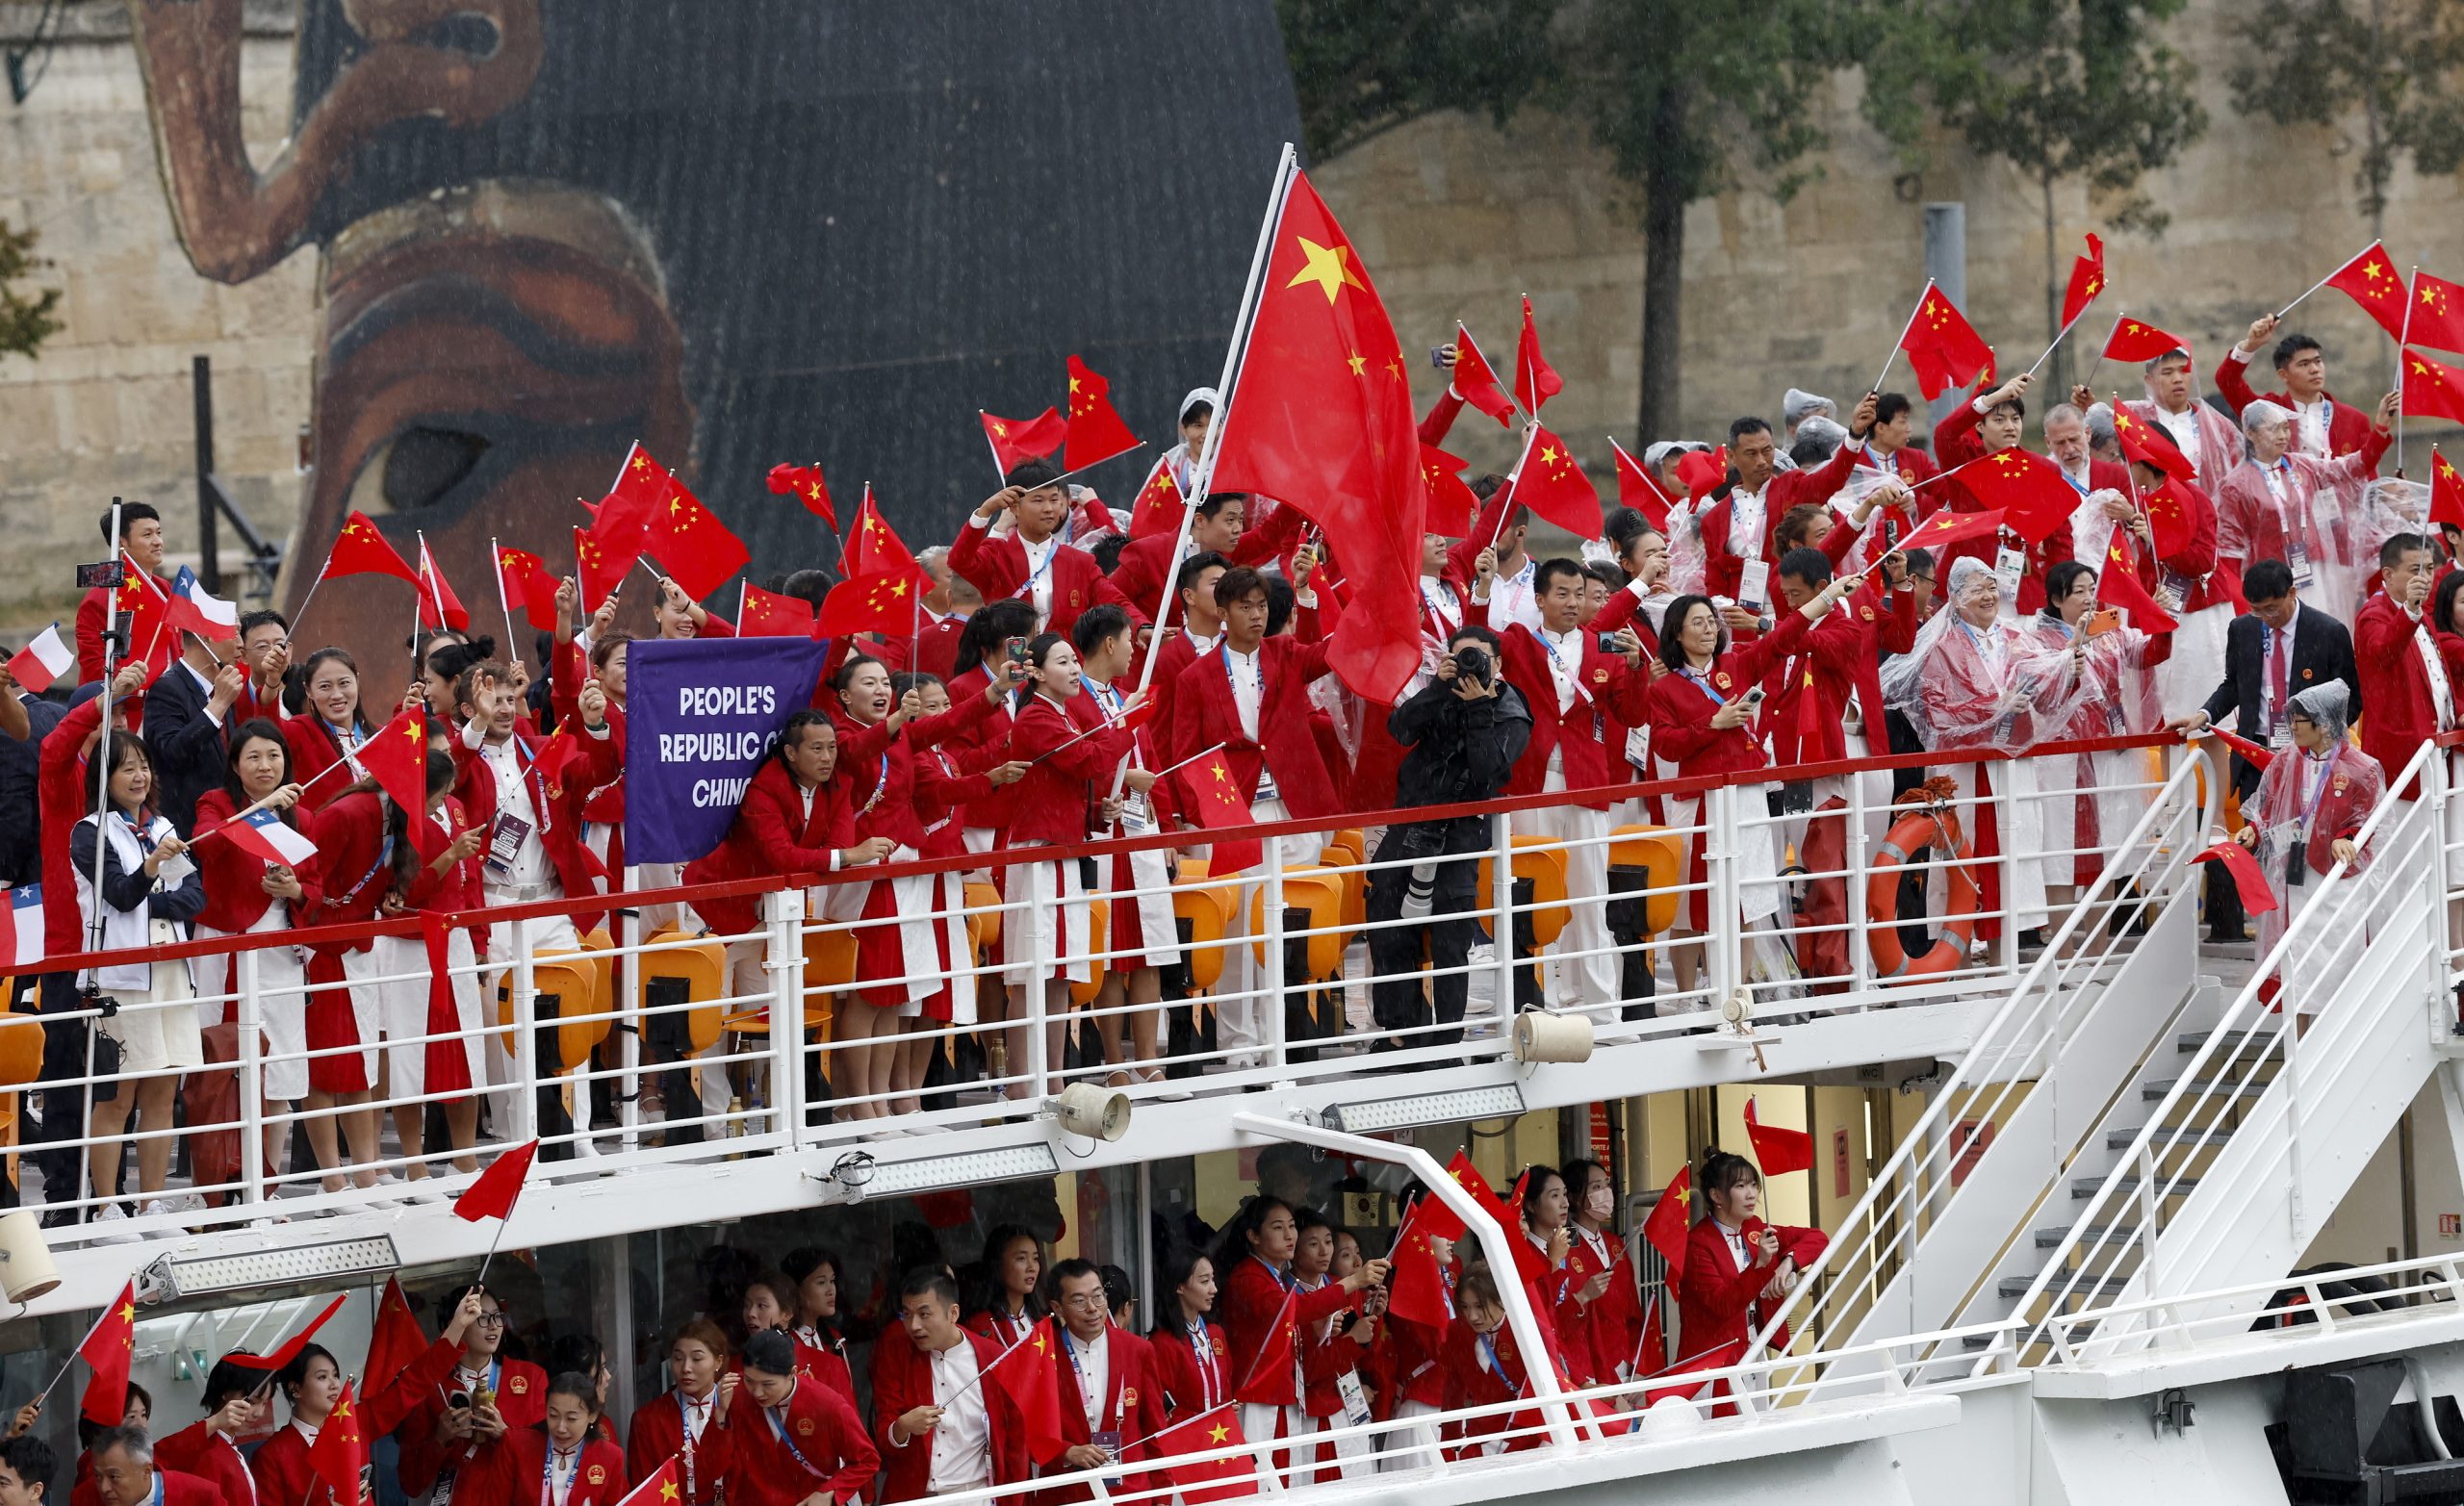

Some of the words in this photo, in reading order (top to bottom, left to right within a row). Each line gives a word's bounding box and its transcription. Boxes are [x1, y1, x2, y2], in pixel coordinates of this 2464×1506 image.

[680, 685, 776, 716] PEOPLE'S
[659, 731, 760, 762] REPUBLIC
[500, 835, 514, 845] CHN
[1862, 1068, 1878, 1078] WC
